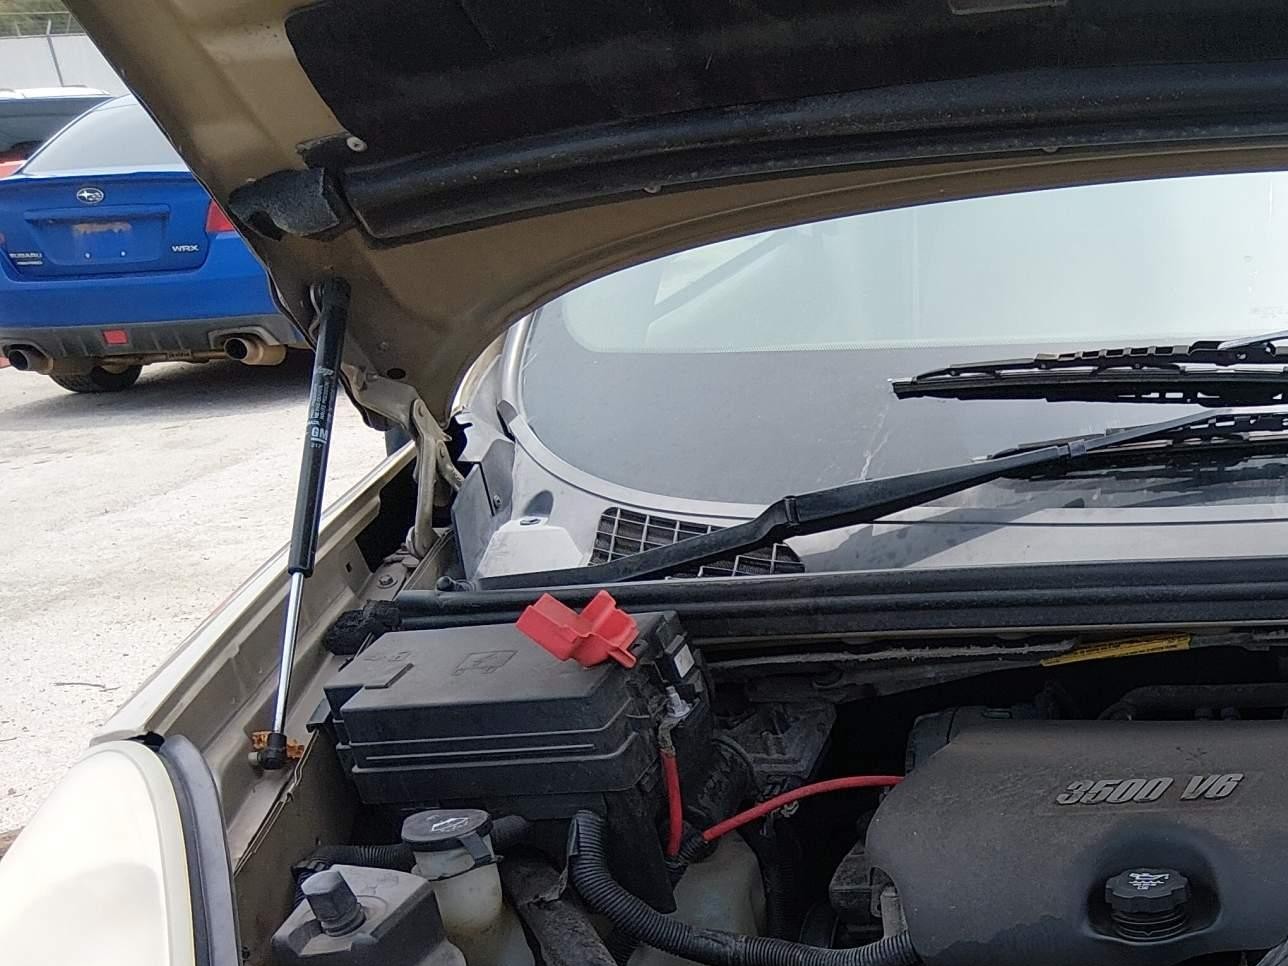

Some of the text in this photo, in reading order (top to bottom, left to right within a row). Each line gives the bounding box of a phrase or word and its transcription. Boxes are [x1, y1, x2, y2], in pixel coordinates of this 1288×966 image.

[171, 244, 199, 252] WRX
[311, 426, 328, 441] GM
[1056, 773, 1245, 805] 3500 V6
